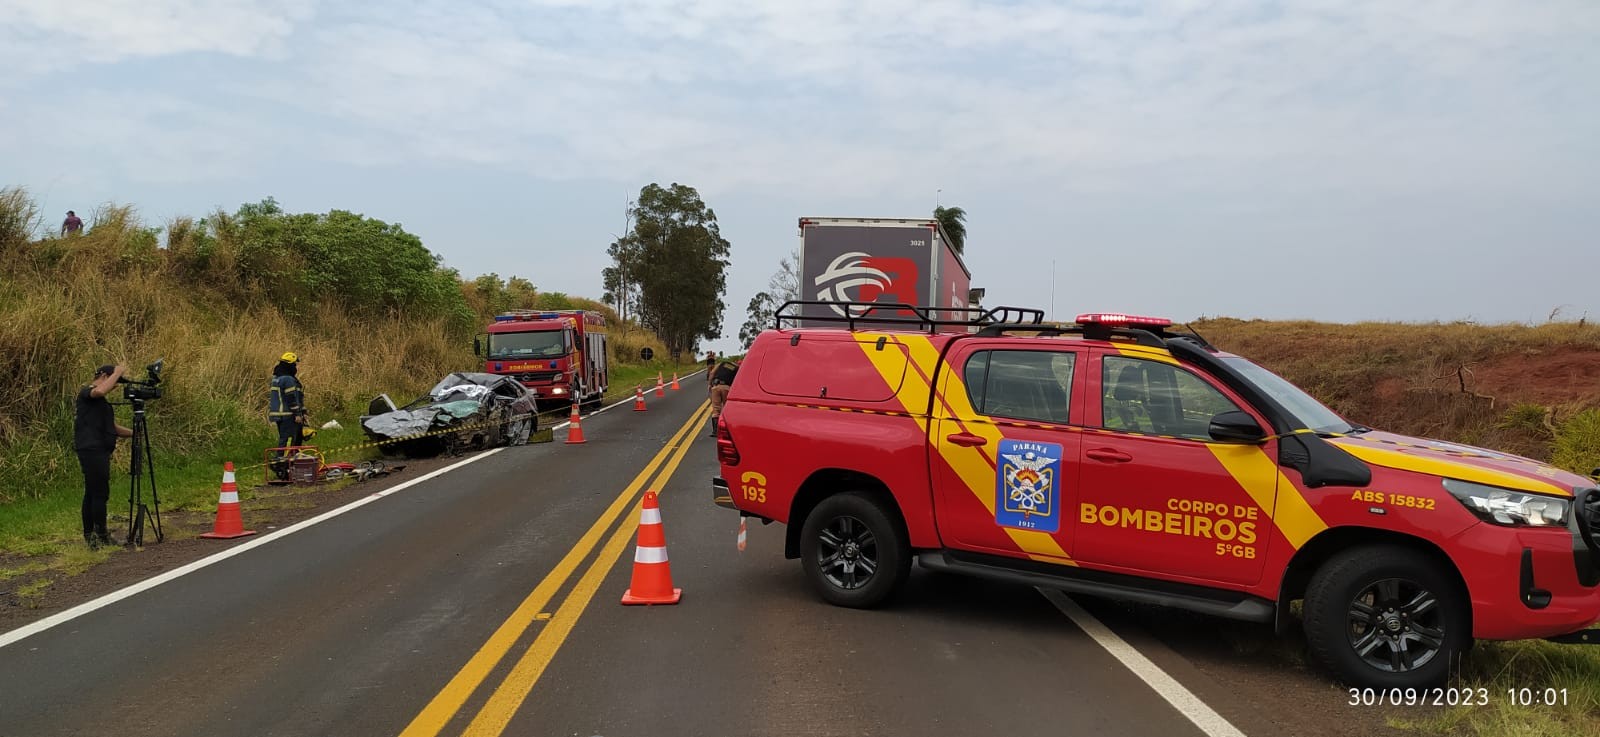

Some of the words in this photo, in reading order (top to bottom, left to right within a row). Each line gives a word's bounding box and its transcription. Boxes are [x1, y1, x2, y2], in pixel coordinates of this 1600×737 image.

[741, 485, 766, 503] 193
[1351, 489, 1386, 504] ABS
[1388, 493, 1436, 511] 15832
[1167, 498, 1229, 517] CORPO
[1233, 505, 1258, 521] DE
[1080, 502, 1257, 544] BOMBEIROS
